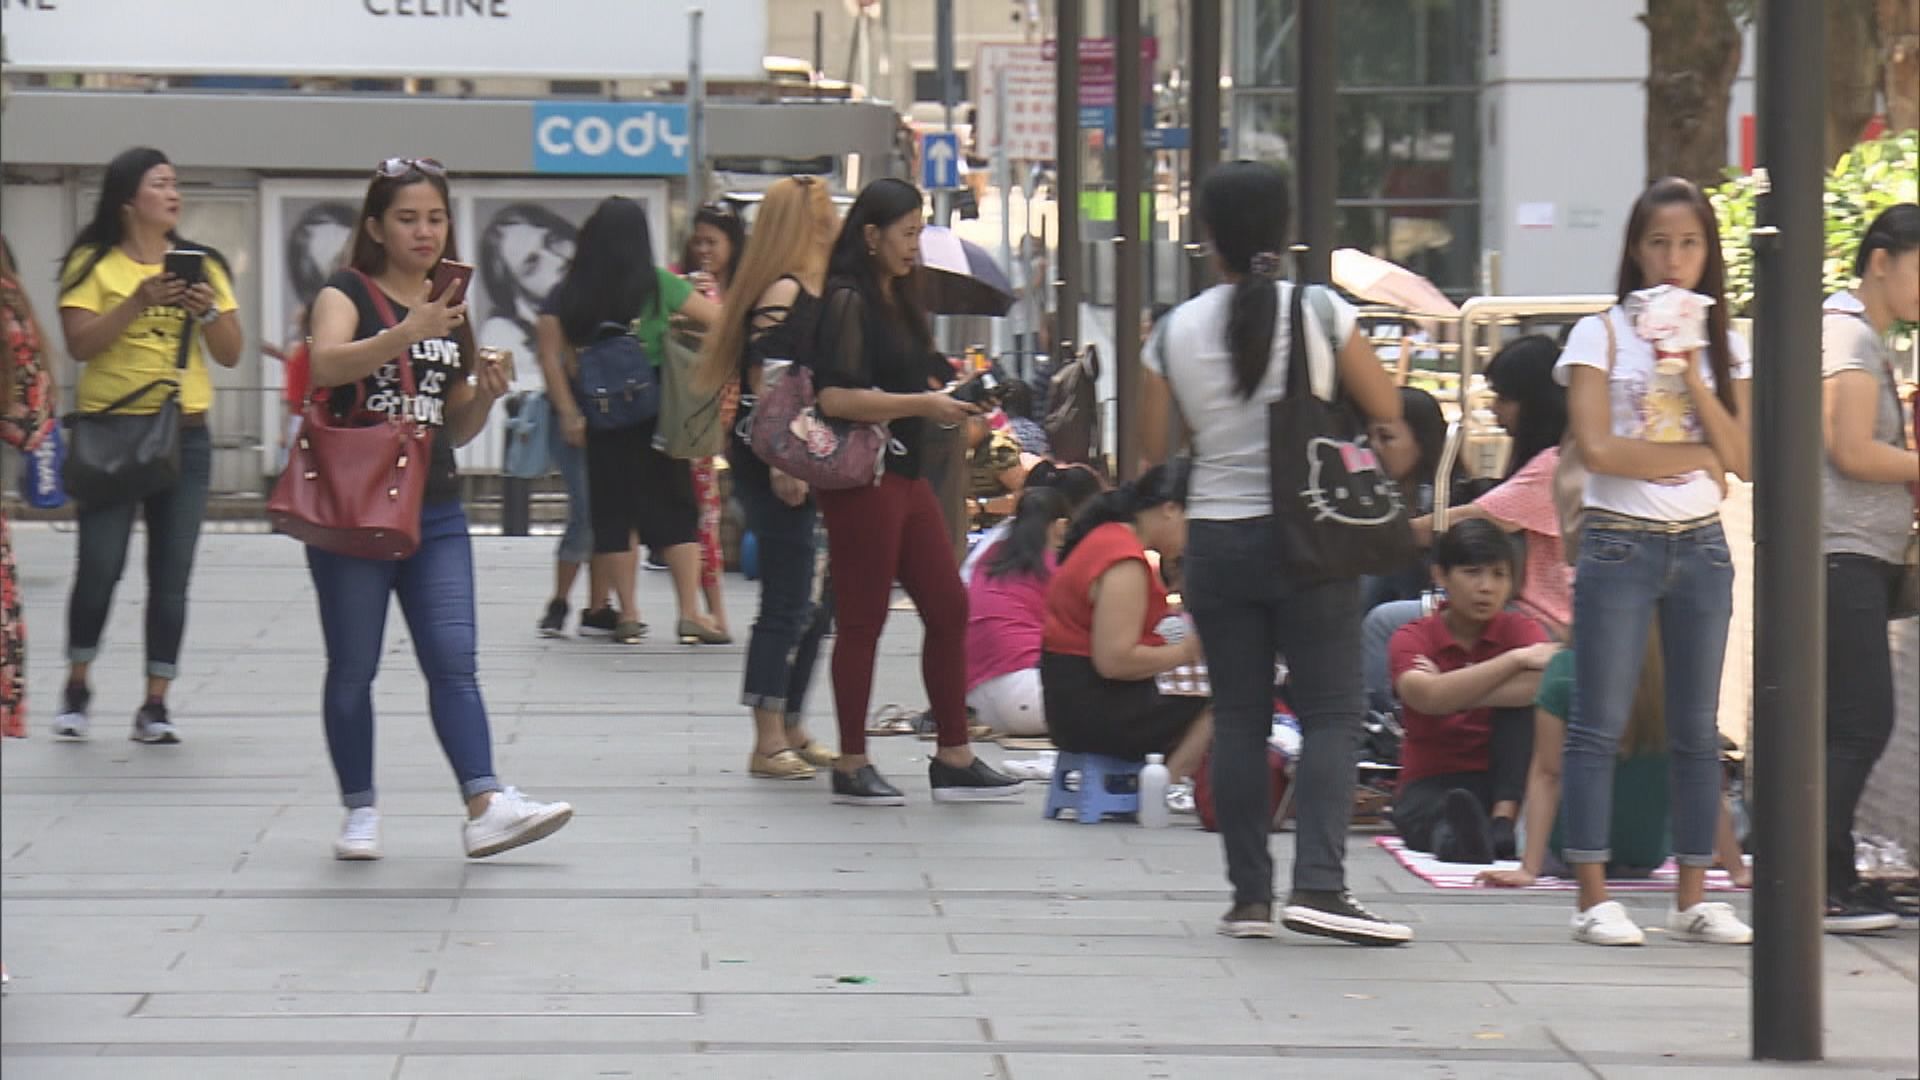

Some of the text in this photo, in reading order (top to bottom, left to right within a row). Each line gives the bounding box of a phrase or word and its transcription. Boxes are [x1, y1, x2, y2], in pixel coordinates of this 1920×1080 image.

[363, 0, 512, 17] CELINE
[538, 111, 689, 158] cody
[411, 339, 461, 368] LOVE
